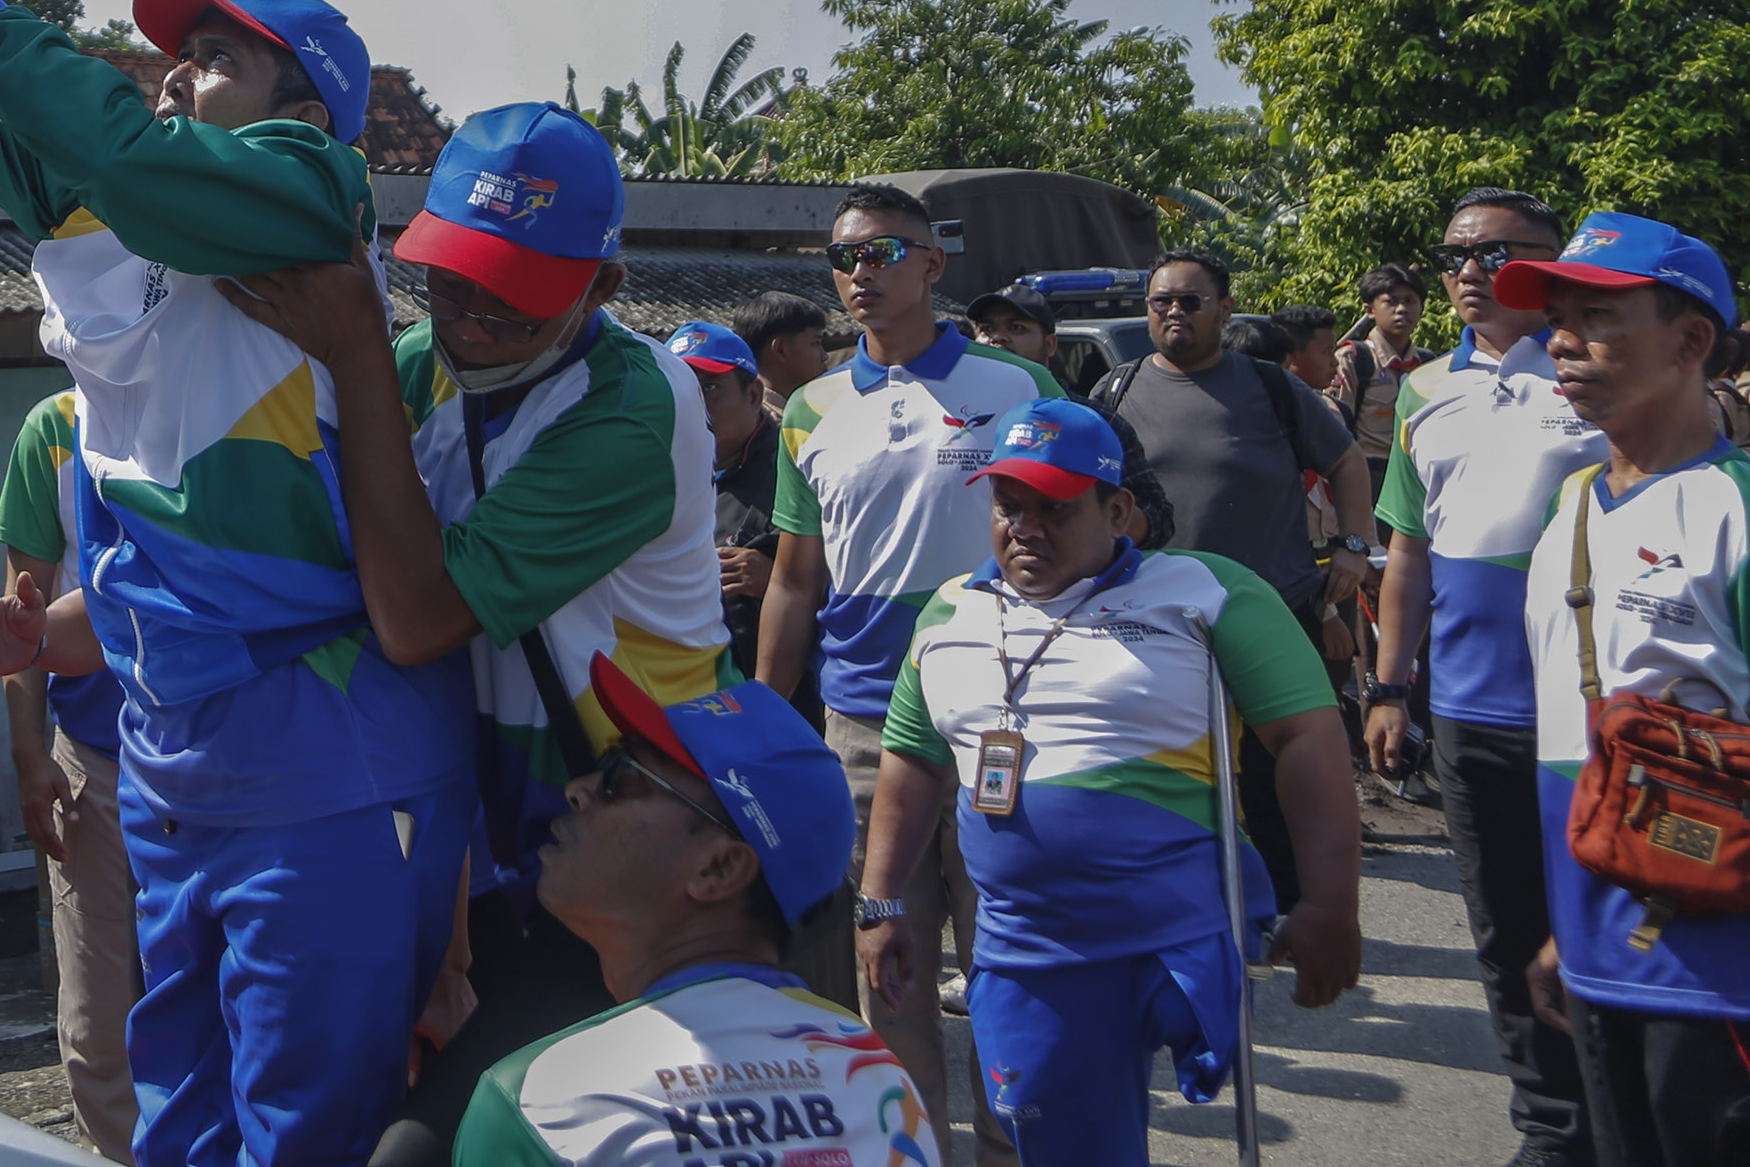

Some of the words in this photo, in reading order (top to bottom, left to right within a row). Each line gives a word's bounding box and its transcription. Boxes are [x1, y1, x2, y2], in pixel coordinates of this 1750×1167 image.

[480, 170, 517, 188] PEPARNAS
[466, 191, 491, 209] API
[473, 179, 515, 203] KIRAB
[156, 266, 168, 287] TENG
[937, 452, 981, 460] PEPARNAS
[655, 1057, 821, 1090] PEPARNAS
[665, 1087, 708, 1101] PEKAN
[663, 1093, 845, 1154] KIRAB
